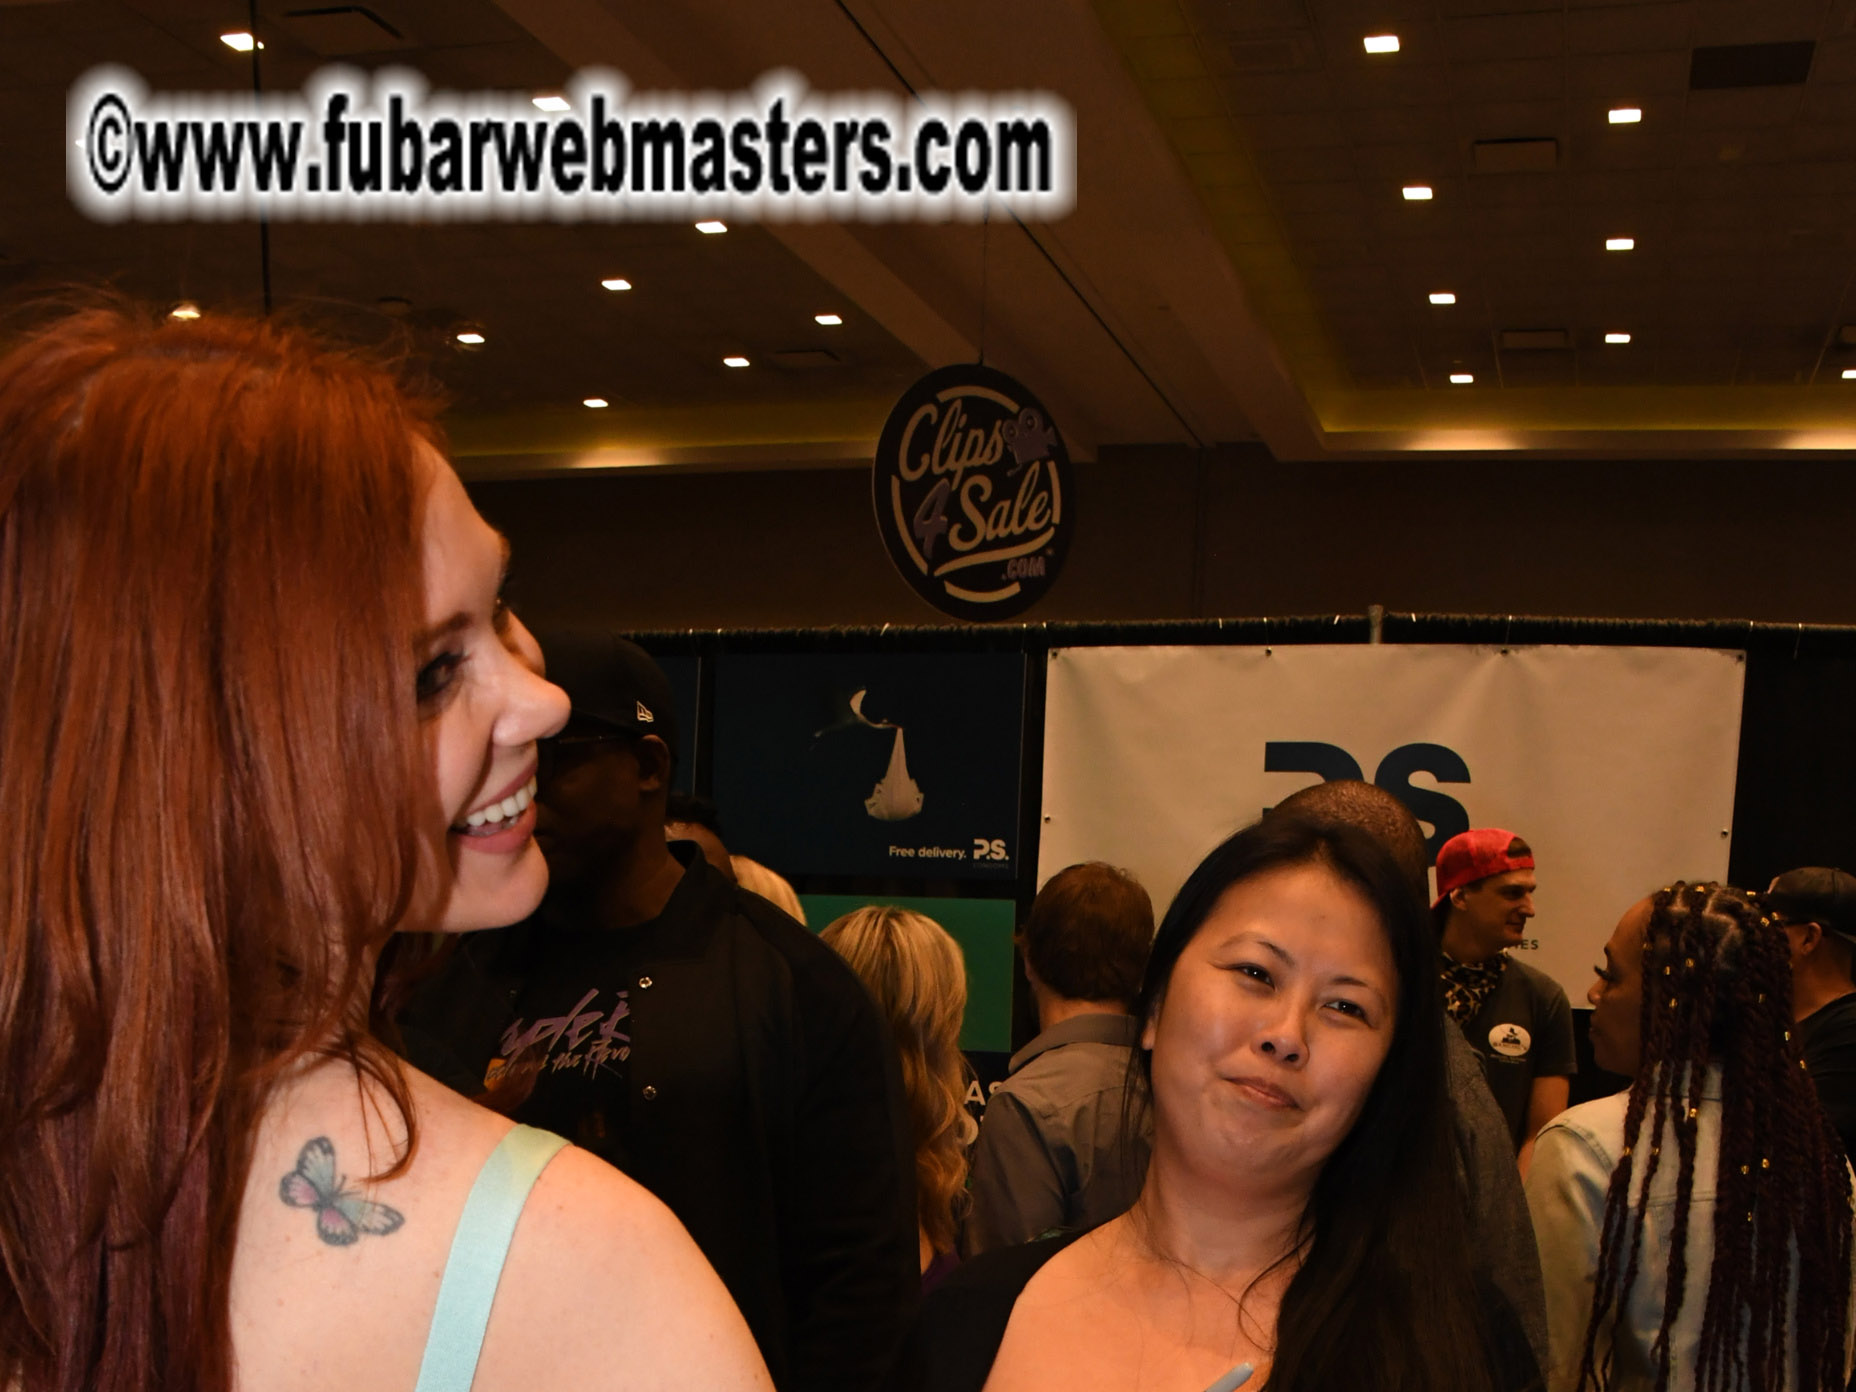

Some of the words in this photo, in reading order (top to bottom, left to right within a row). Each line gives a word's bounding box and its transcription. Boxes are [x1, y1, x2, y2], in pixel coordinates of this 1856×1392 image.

[898, 399, 1003, 490] Clips
[949, 461, 1051, 551] Sale
[889, 845, 914, 858] Free
[918, 845, 967, 860] delivery.
